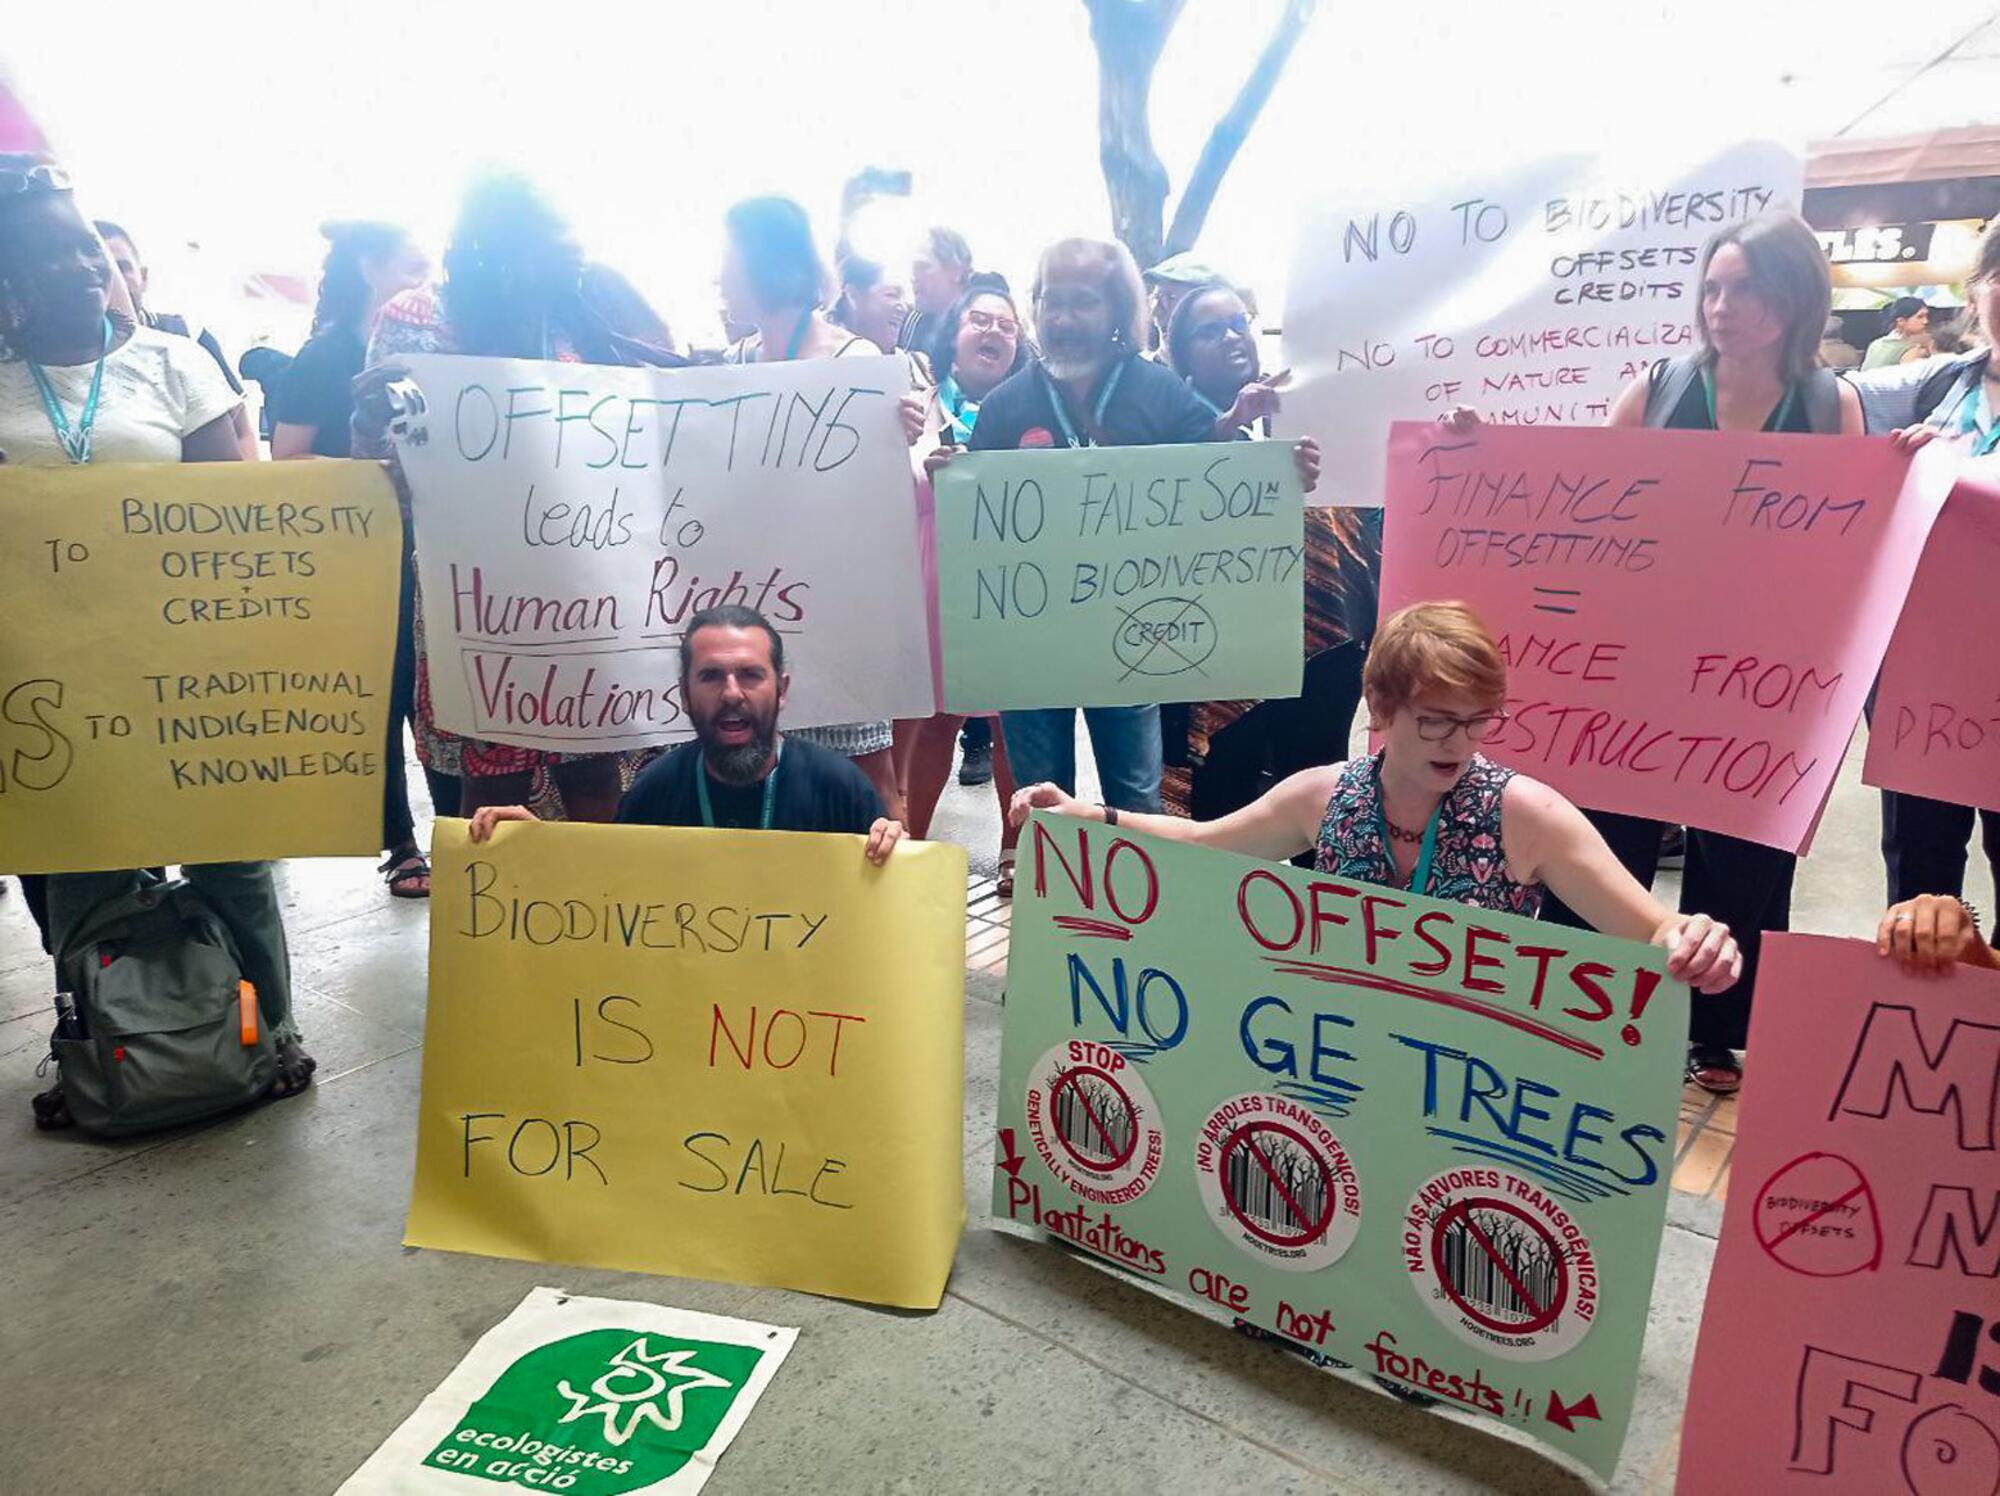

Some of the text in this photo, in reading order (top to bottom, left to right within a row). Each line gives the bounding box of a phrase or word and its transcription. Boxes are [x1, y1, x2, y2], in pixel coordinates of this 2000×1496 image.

[1344, 186, 1773, 263] NO TO BIODIVERSITY
[1551, 247, 1696, 279] OFFSETS
[1555, 282, 1683, 305] CREDITS
[1338, 341, 1395, 372] NO
[1415, 334, 1454, 359] TO
[1425, 381, 1461, 400] OF
[1482, 367, 1591, 394] NATURE
[973, 479, 1045, 543] NO
[1079, 473, 1191, 537] FALSE
[1419, 442, 1867, 535] FINANCE FROM
[122, 497, 375, 537] BIODIVERSITY
[524, 484, 705, 550] leads to
[45, 539, 89, 572] TO
[161, 551, 315, 578] OFFSETS
[1435, 528, 1659, 572] OFFSETTING
[450, 563, 624, 635] Human
[972, 544, 1304, 620] NO BIODIVERSITY
[164, 596, 311, 625] CREDITS
[1123, 620, 1206, 647] CREDIT
[144, 671, 374, 703] TRADITIONAL
[473, 655, 683, 729] Violations
[1692, 653, 1844, 715] FROM
[85, 715, 131, 739] TO
[157, 709, 365, 743] INDIGENOUS
[170, 752, 376, 790] KNOWLEDGE
[460, 861, 828, 952] BIODIVERSITY
[1032, 820, 1662, 1046] NO OFFSETS!
[575, 994, 865, 1077] IS NOT
[1068, 1040, 1127, 1073] STOP
[1067, 952, 1666, 1186] NO GE TREES
[460, 1114, 854, 1209] FOR SALE
[1028, 1090, 1073, 1183] GENETICALLY
[1070, 1178, 1146, 1204] ENGINEERED
[1141, 1130, 1161, 1180] TREES!
[1766, 1197, 1861, 1219] BIODIVERSITY
[1779, 1221, 1856, 1239] OFFSETS
[1008, 1176, 1165, 1274] Plantations
[1189, 1267, 1250, 1311] are
[1277, 1301, 1336, 1344] not
[435, 1448, 581, 1489] en acció
[455, 1428, 634, 1474] ecologistes
